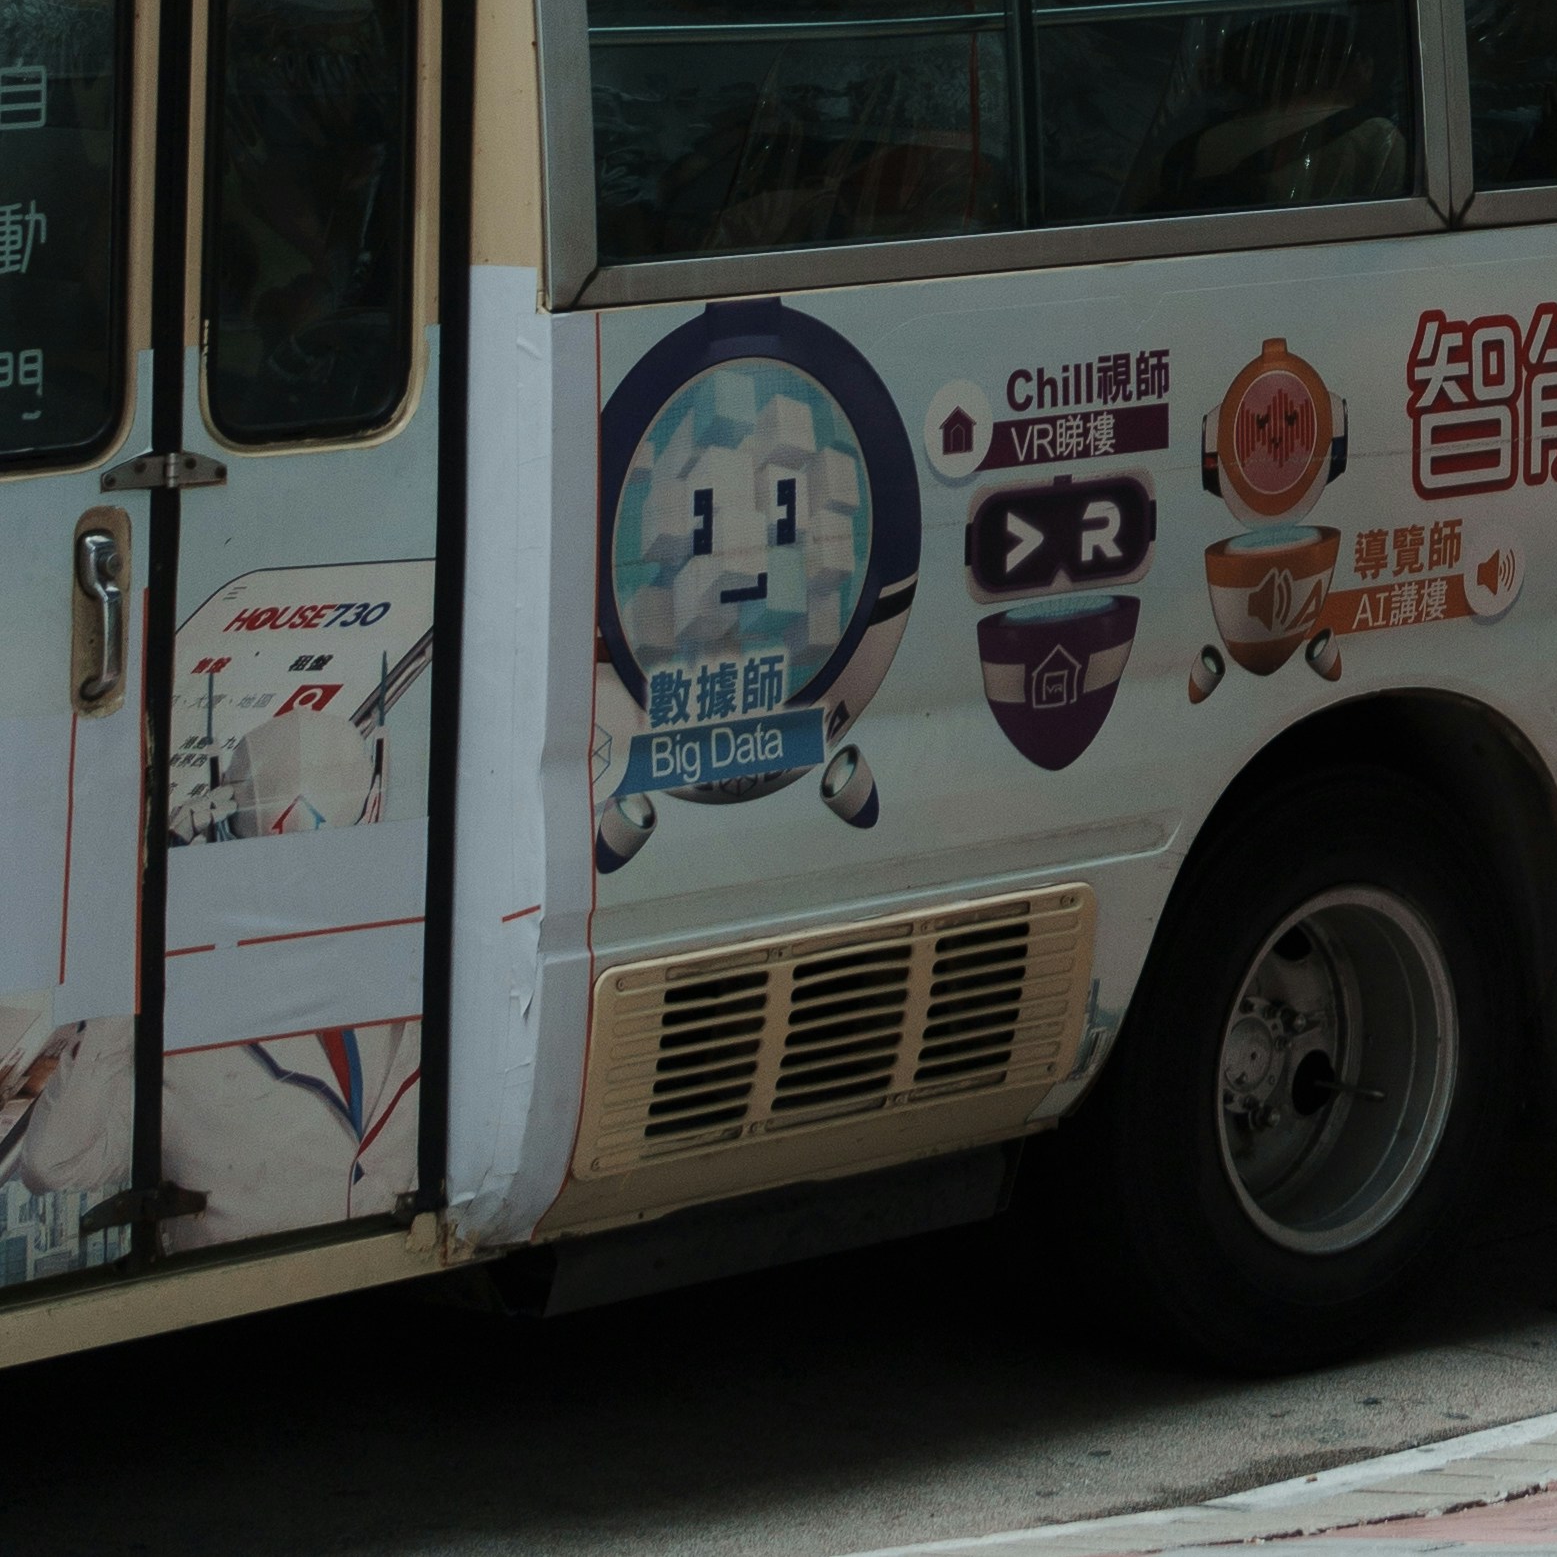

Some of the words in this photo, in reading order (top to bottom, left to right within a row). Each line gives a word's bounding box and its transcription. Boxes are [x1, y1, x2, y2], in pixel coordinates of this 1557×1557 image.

[1006, 349, 1171, 413] Chill視師
[1009, 410, 1118, 464] VR睇樓
[1352, 516, 1465, 579] 導覽師
[222, 601, 392, 633] HOUSE730
[647, 652, 787, 730] 數據師
[650, 732, 702, 784] Big
[710, 723, 785, 770] Data
